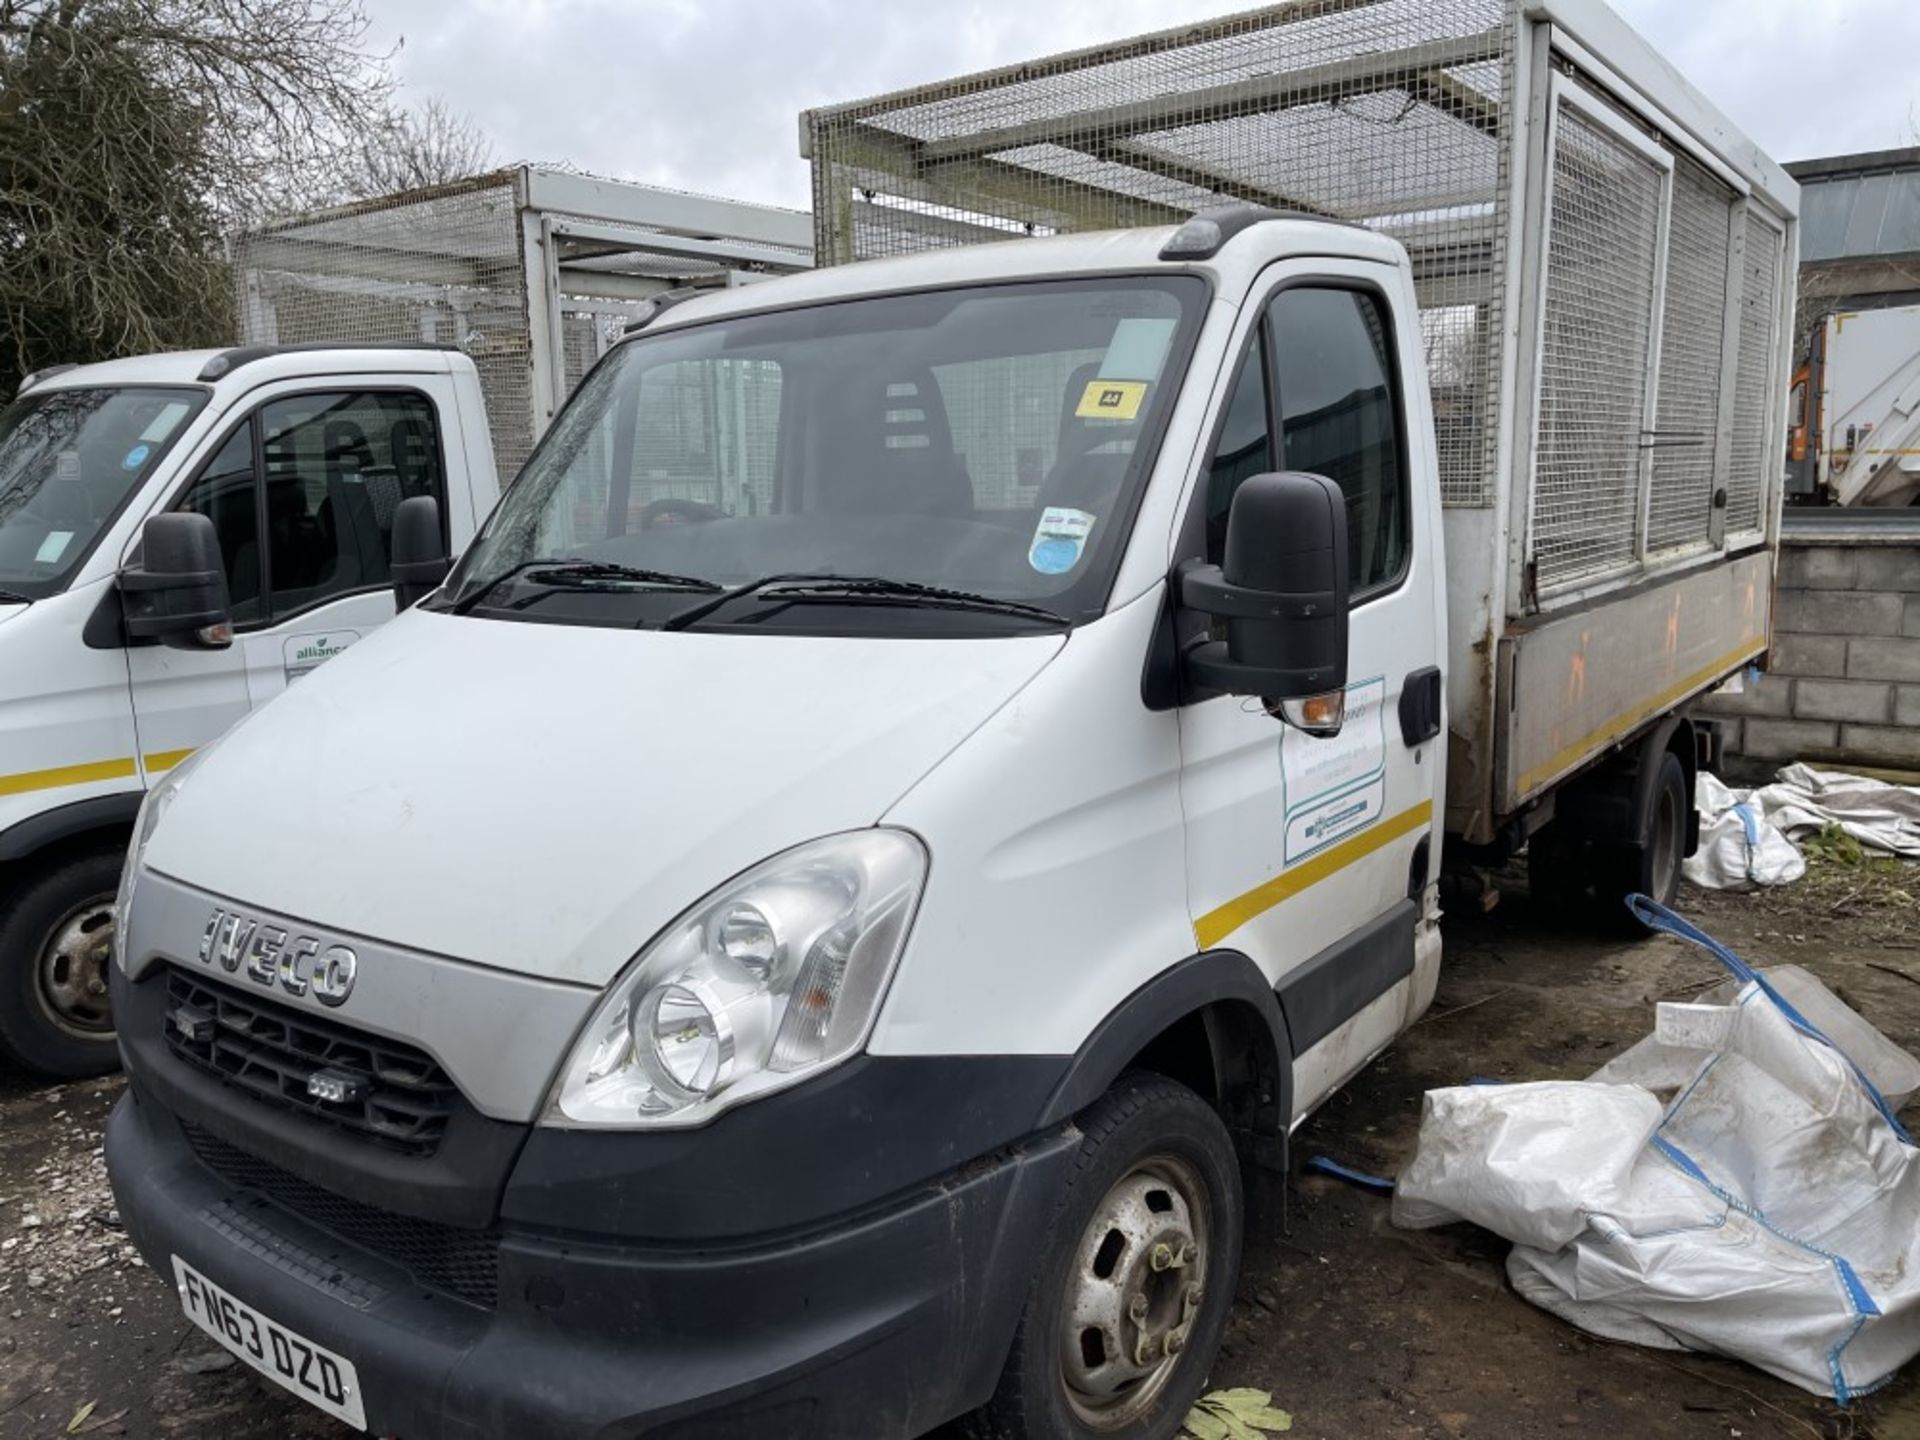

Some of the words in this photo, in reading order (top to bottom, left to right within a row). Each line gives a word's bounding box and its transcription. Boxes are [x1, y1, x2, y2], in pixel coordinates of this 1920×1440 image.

[199, 907, 358, 1008] IVECO
[183, 1268, 264, 1361] FN63
[268, 1324, 345, 1407] DZD
